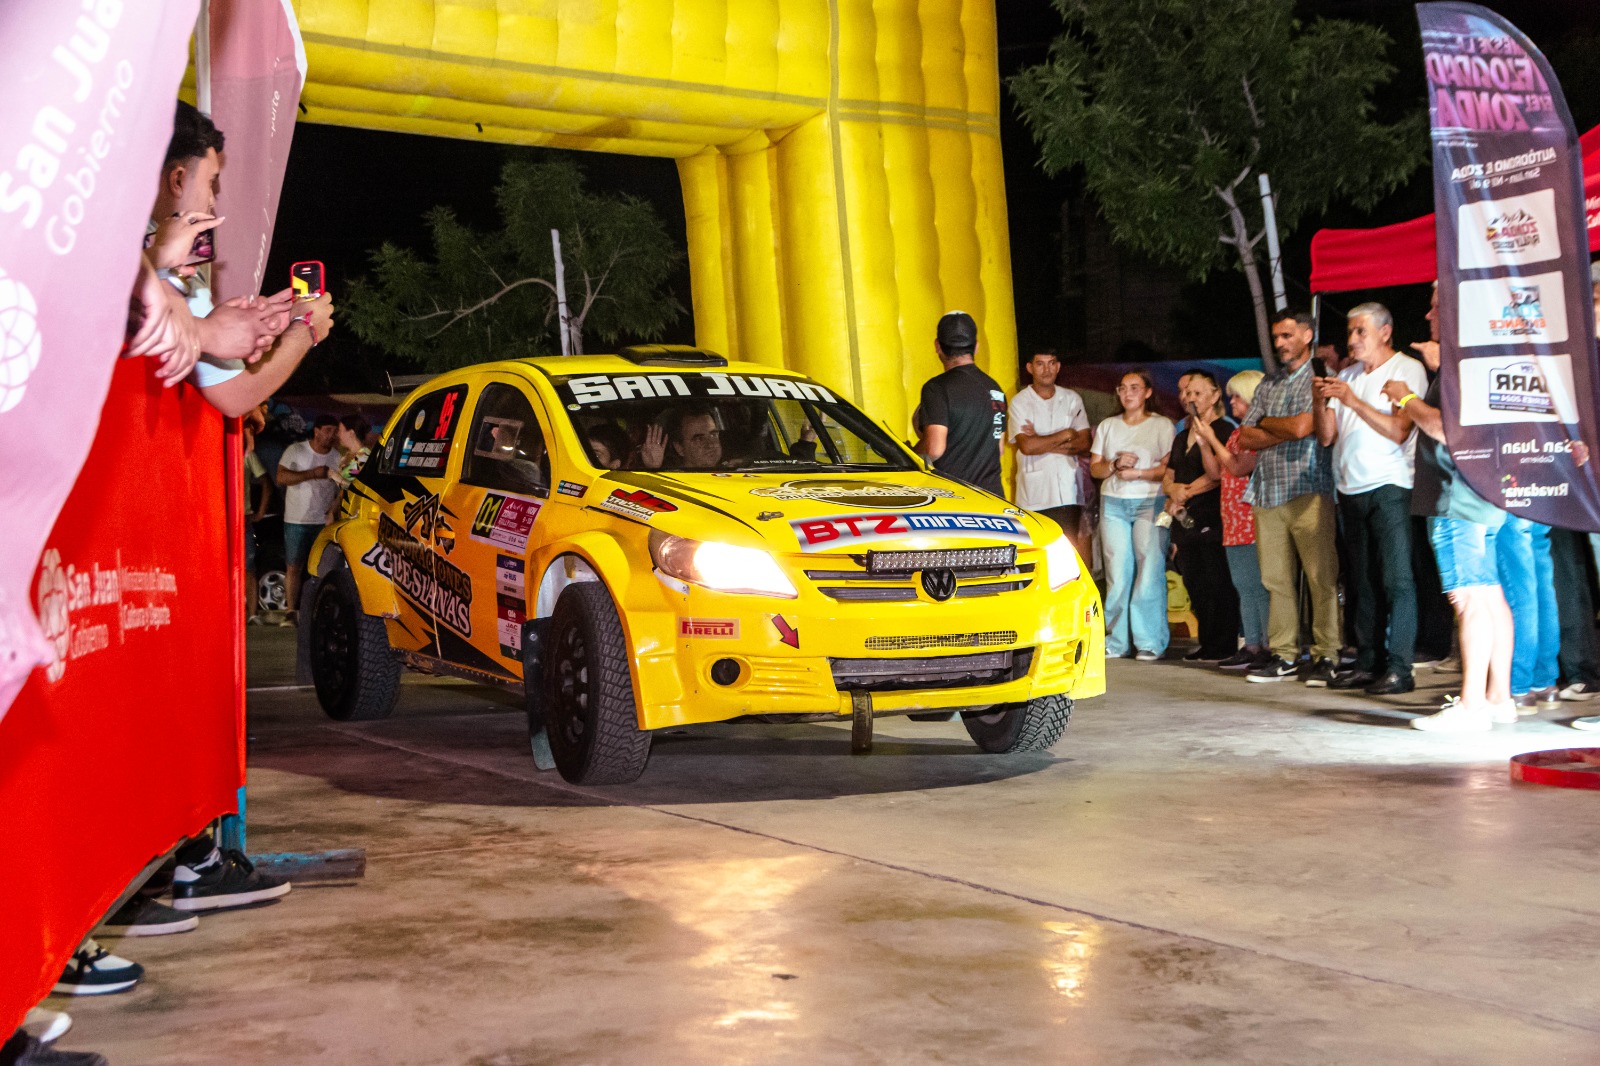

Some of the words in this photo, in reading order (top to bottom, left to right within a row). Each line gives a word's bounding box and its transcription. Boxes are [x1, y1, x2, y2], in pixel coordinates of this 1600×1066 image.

[0, 105, 76, 229] San
[45, 59, 133, 255] Gobierno
[800, 515, 908, 545] BTZ
[909, 516, 1014, 531] MINERA
[67, 563, 91, 611] San
[93, 561, 120, 605] Juan
[362, 541, 470, 634] IGLESIANAS
[682, 621, 734, 635] PIRELLI
